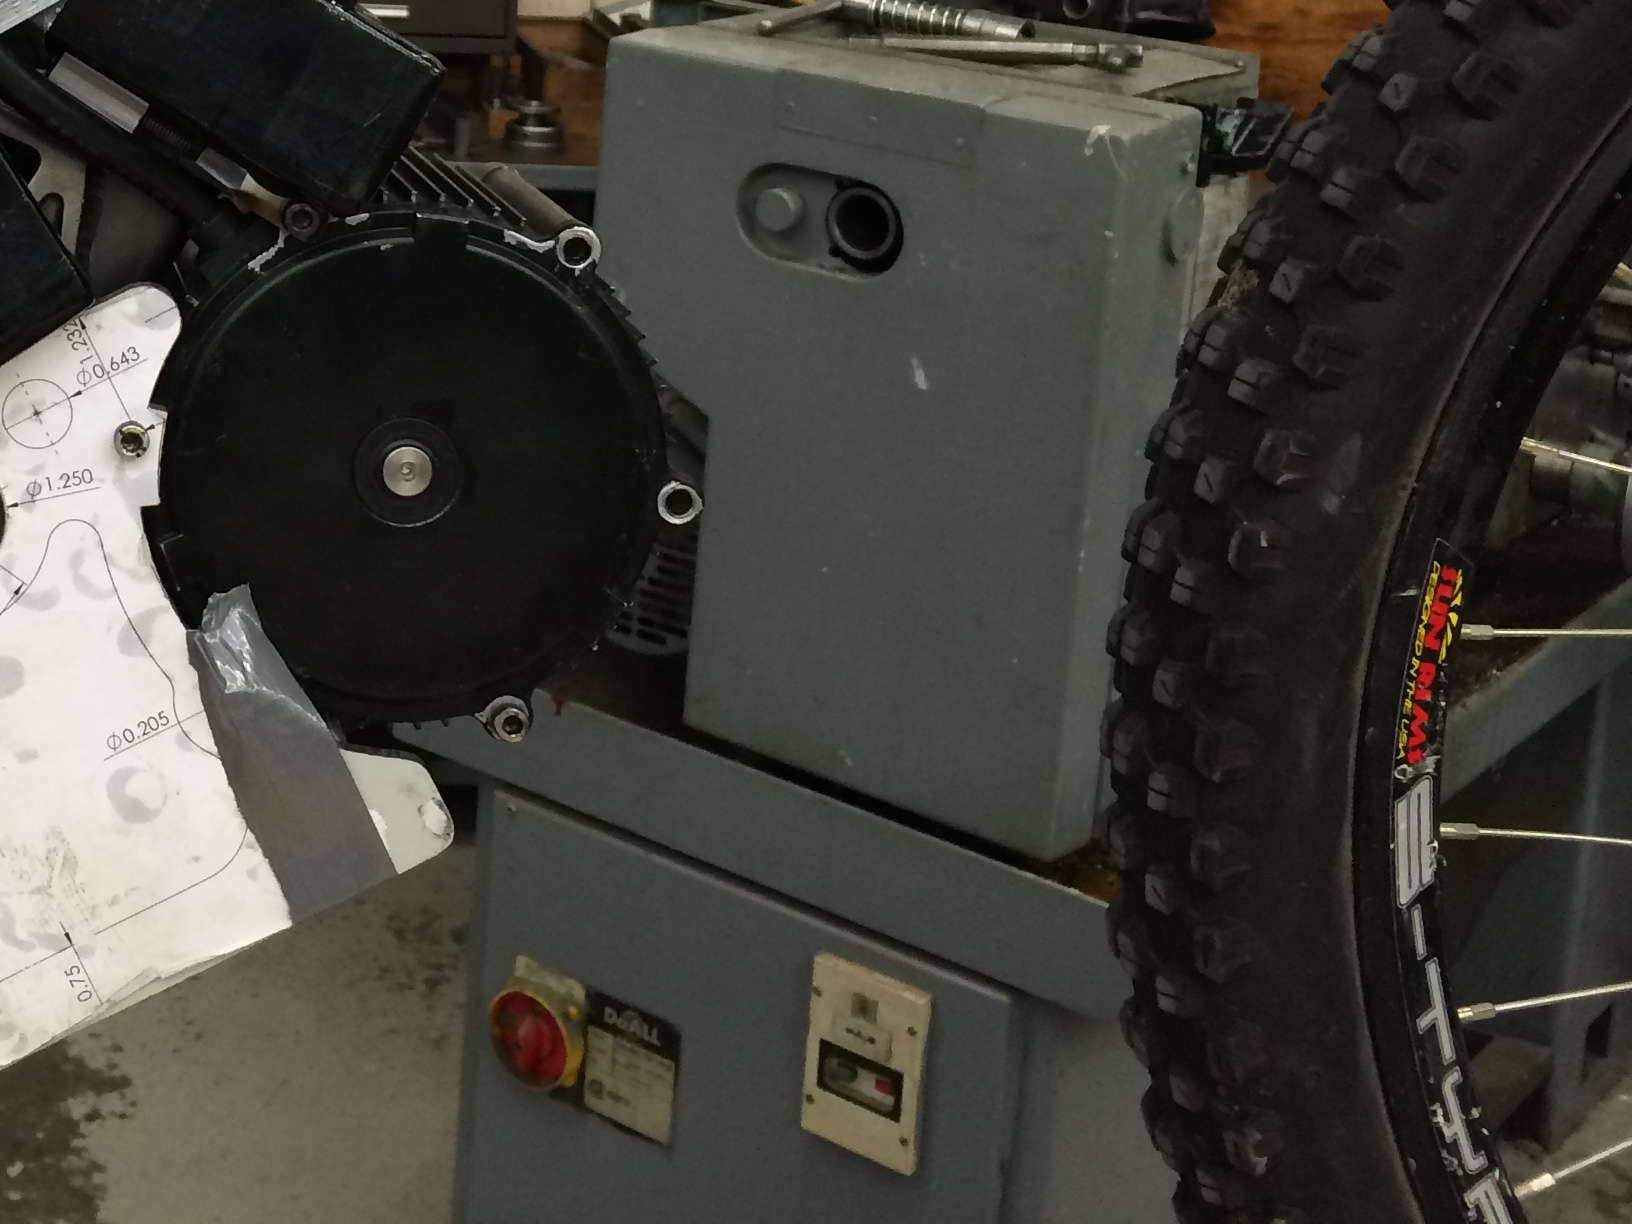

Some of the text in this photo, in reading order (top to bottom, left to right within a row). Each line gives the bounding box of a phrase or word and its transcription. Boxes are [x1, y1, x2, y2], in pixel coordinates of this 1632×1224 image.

[1395, 560, 1441, 760] DESIGNED IN THE USA
[63, 964, 93, 1003] 0.75
